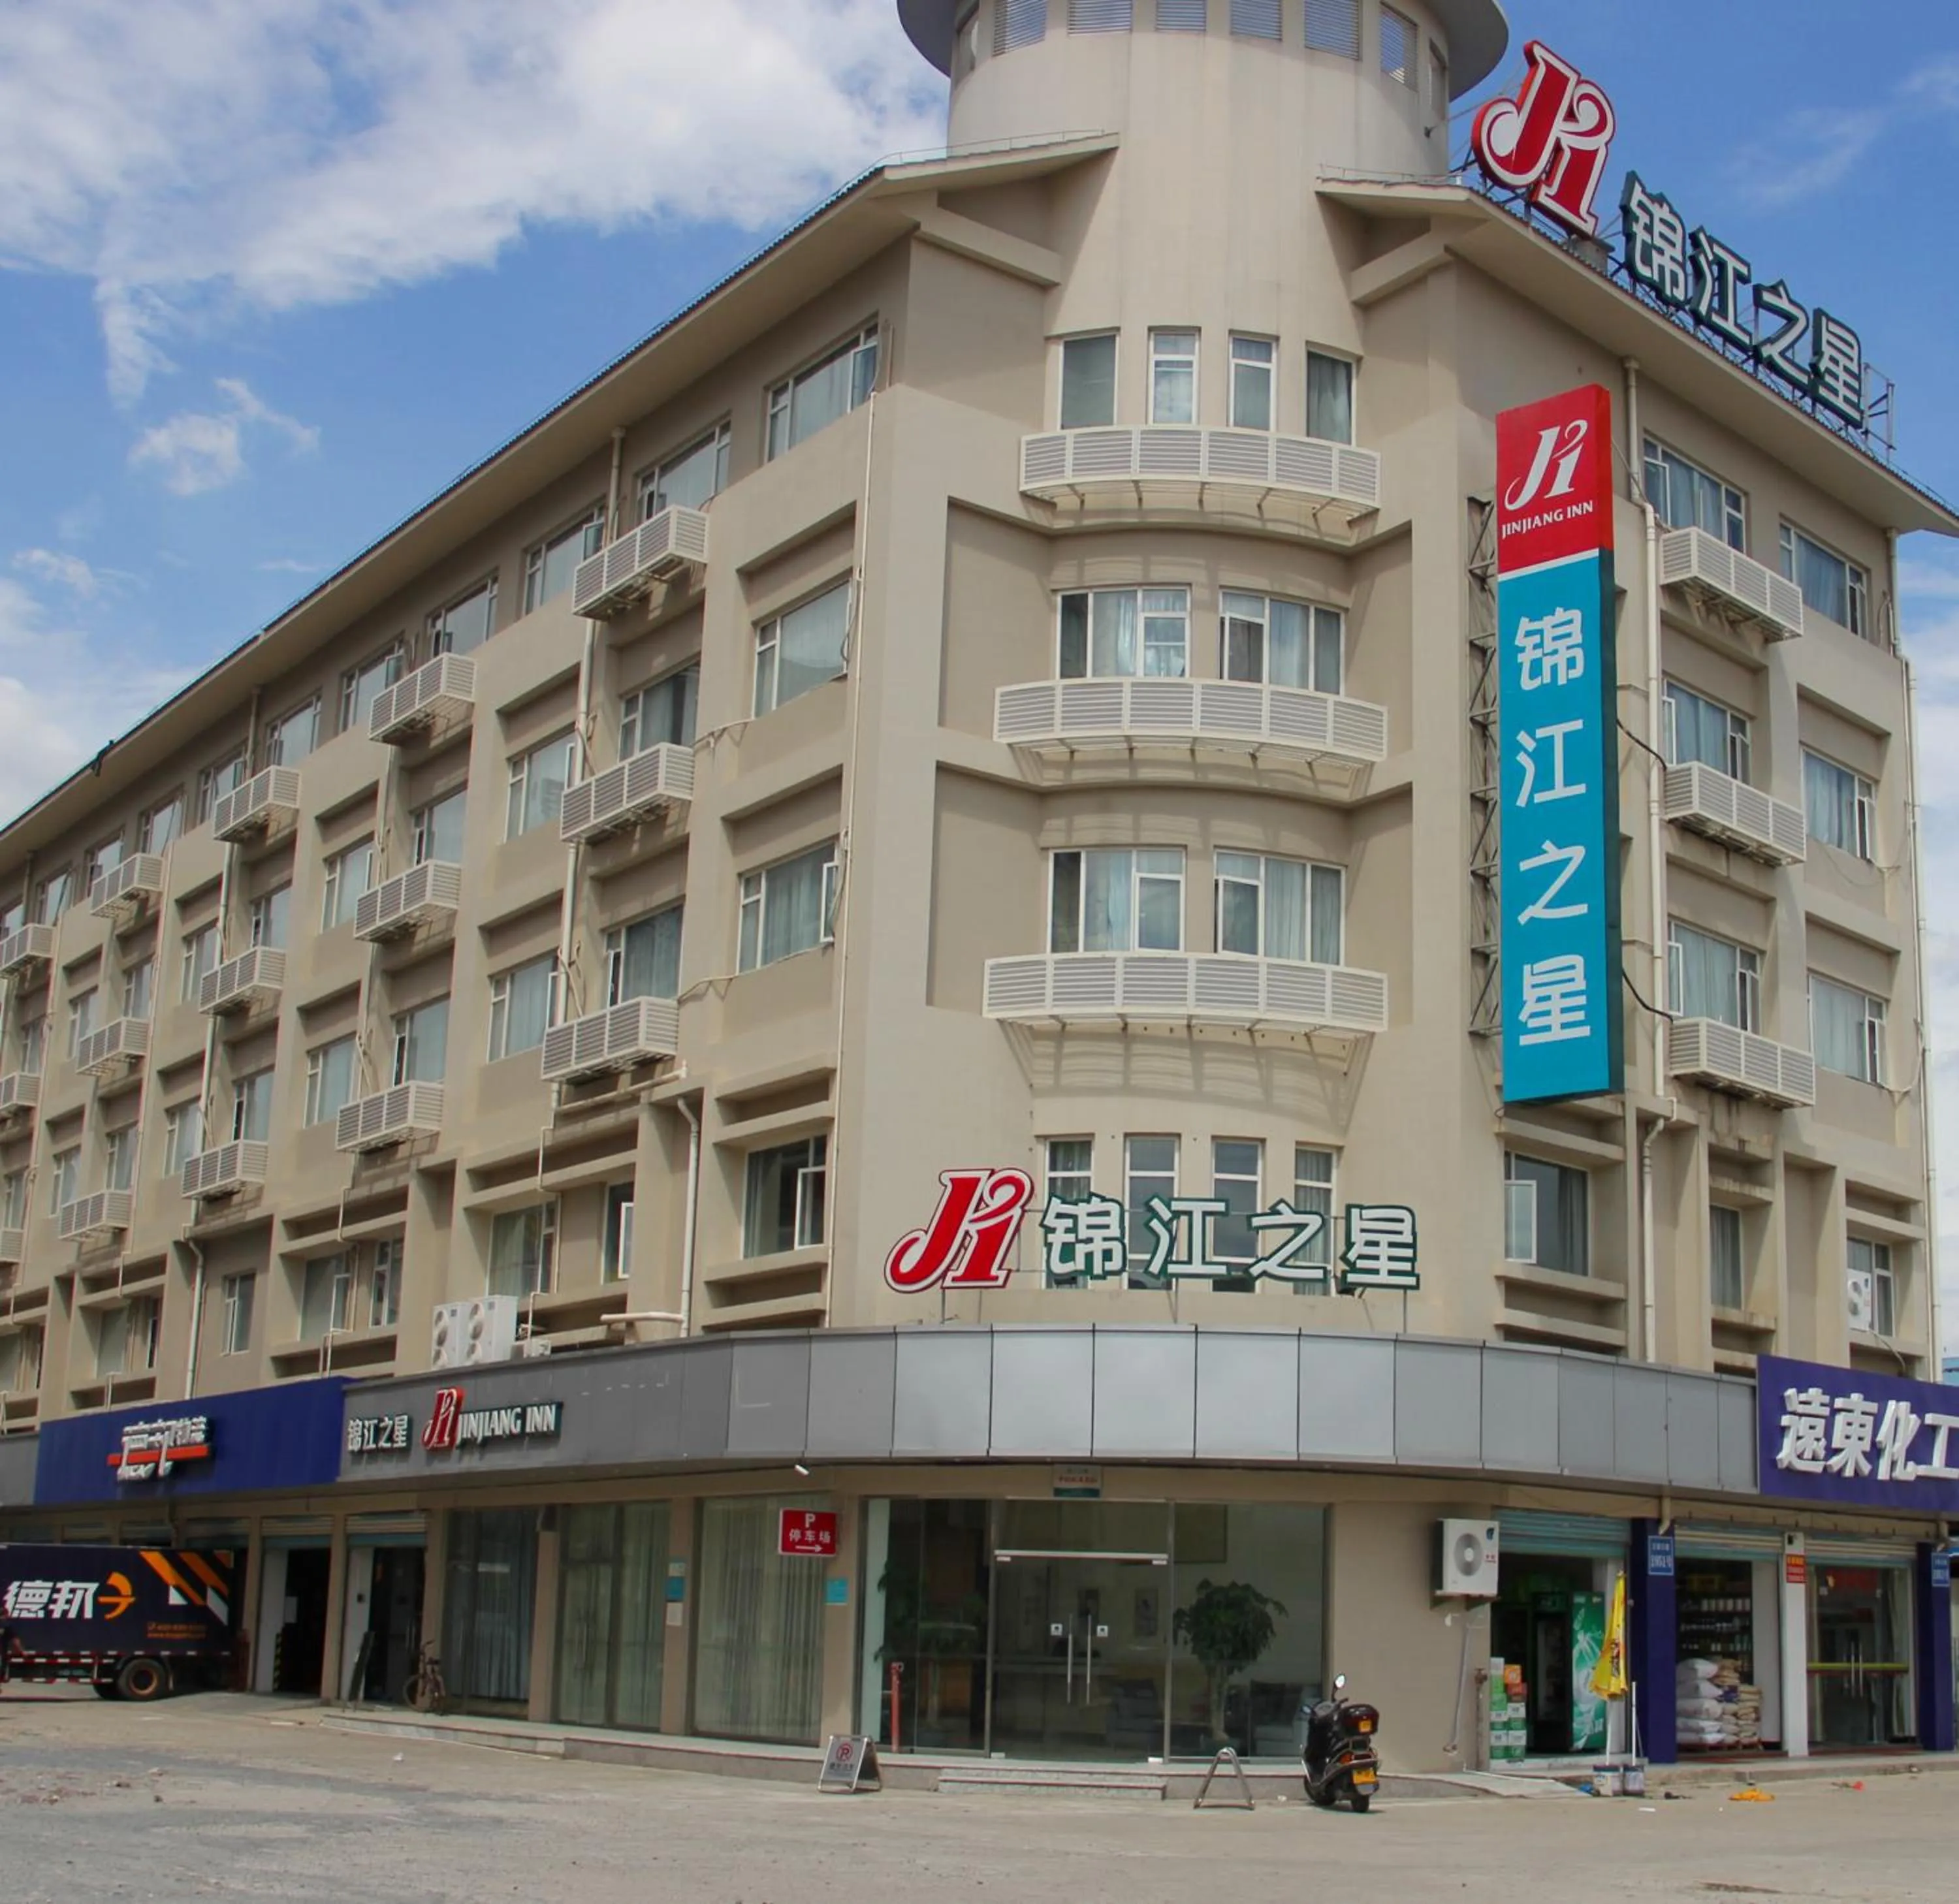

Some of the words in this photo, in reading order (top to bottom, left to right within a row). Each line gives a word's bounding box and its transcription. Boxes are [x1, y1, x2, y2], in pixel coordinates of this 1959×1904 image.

[1619, 170, 1863, 428] 锦江之星
[1501, 508, 1564, 539] JINJIANG
[1567, 500, 1594, 518] INN
[1514, 607, 1591, 1046] 锦江之星
[1042, 1191, 1421, 1290] 锦江之星
[347, 1414, 409, 1453] 锦江之星
[456, 1407, 521, 1446] JINJIANG
[525, 1404, 556, 1433] INN
[1776, 1388, 1959, 1481] 遠東化工
[789, 1529, 831, 1544] 停车场
[804, 1513, 816, 1528] P
[3, 1580, 99, 1619] 德邦
